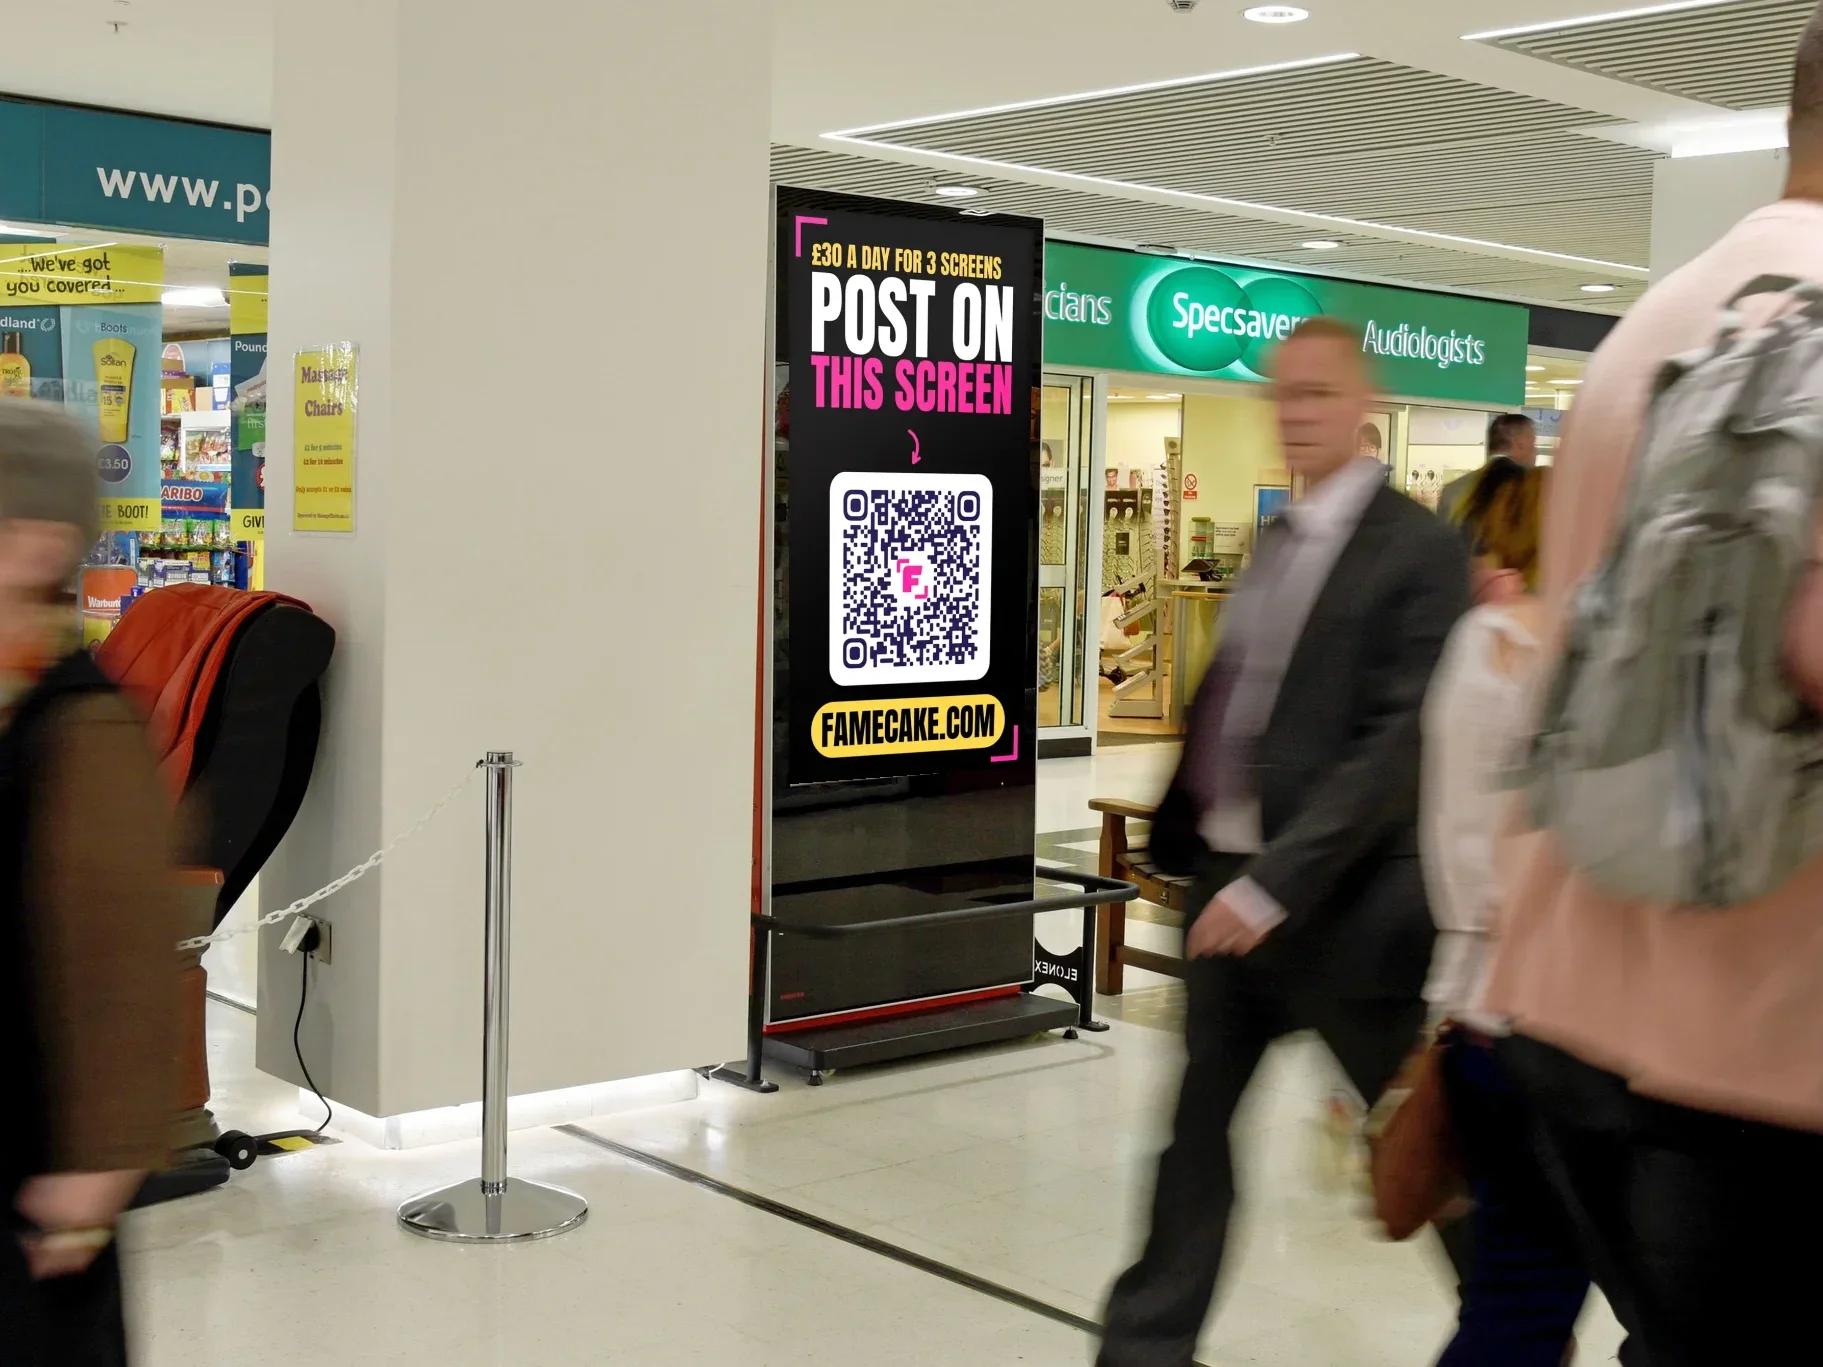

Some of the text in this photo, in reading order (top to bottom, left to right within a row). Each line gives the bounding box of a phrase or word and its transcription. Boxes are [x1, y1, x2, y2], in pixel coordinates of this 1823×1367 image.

[96, 167, 270, 223] www.p
[83, 251, 111, 274] got
[811, 242, 1002, 280] £30 A DAY FOR 3 SCREENS
[6, 280, 40, 297] you
[1044, 281, 1112, 325] cians
[100, 323, 128, 334] Boots
[811, 271, 1014, 362] POST ON
[1172, 291, 1309, 341] Specsaver
[100, 355, 127, 367] Soltan
[1362, 319, 1485, 369] Audiologists
[810, 354, 1013, 415] THIS SCREEN
[304, 399, 344, 417] Chairs
[116, 504, 149, 519] BOOT!
[87, 595, 121, 608] Warburt
[821, 703, 996, 748] FAMECAKE.COM
